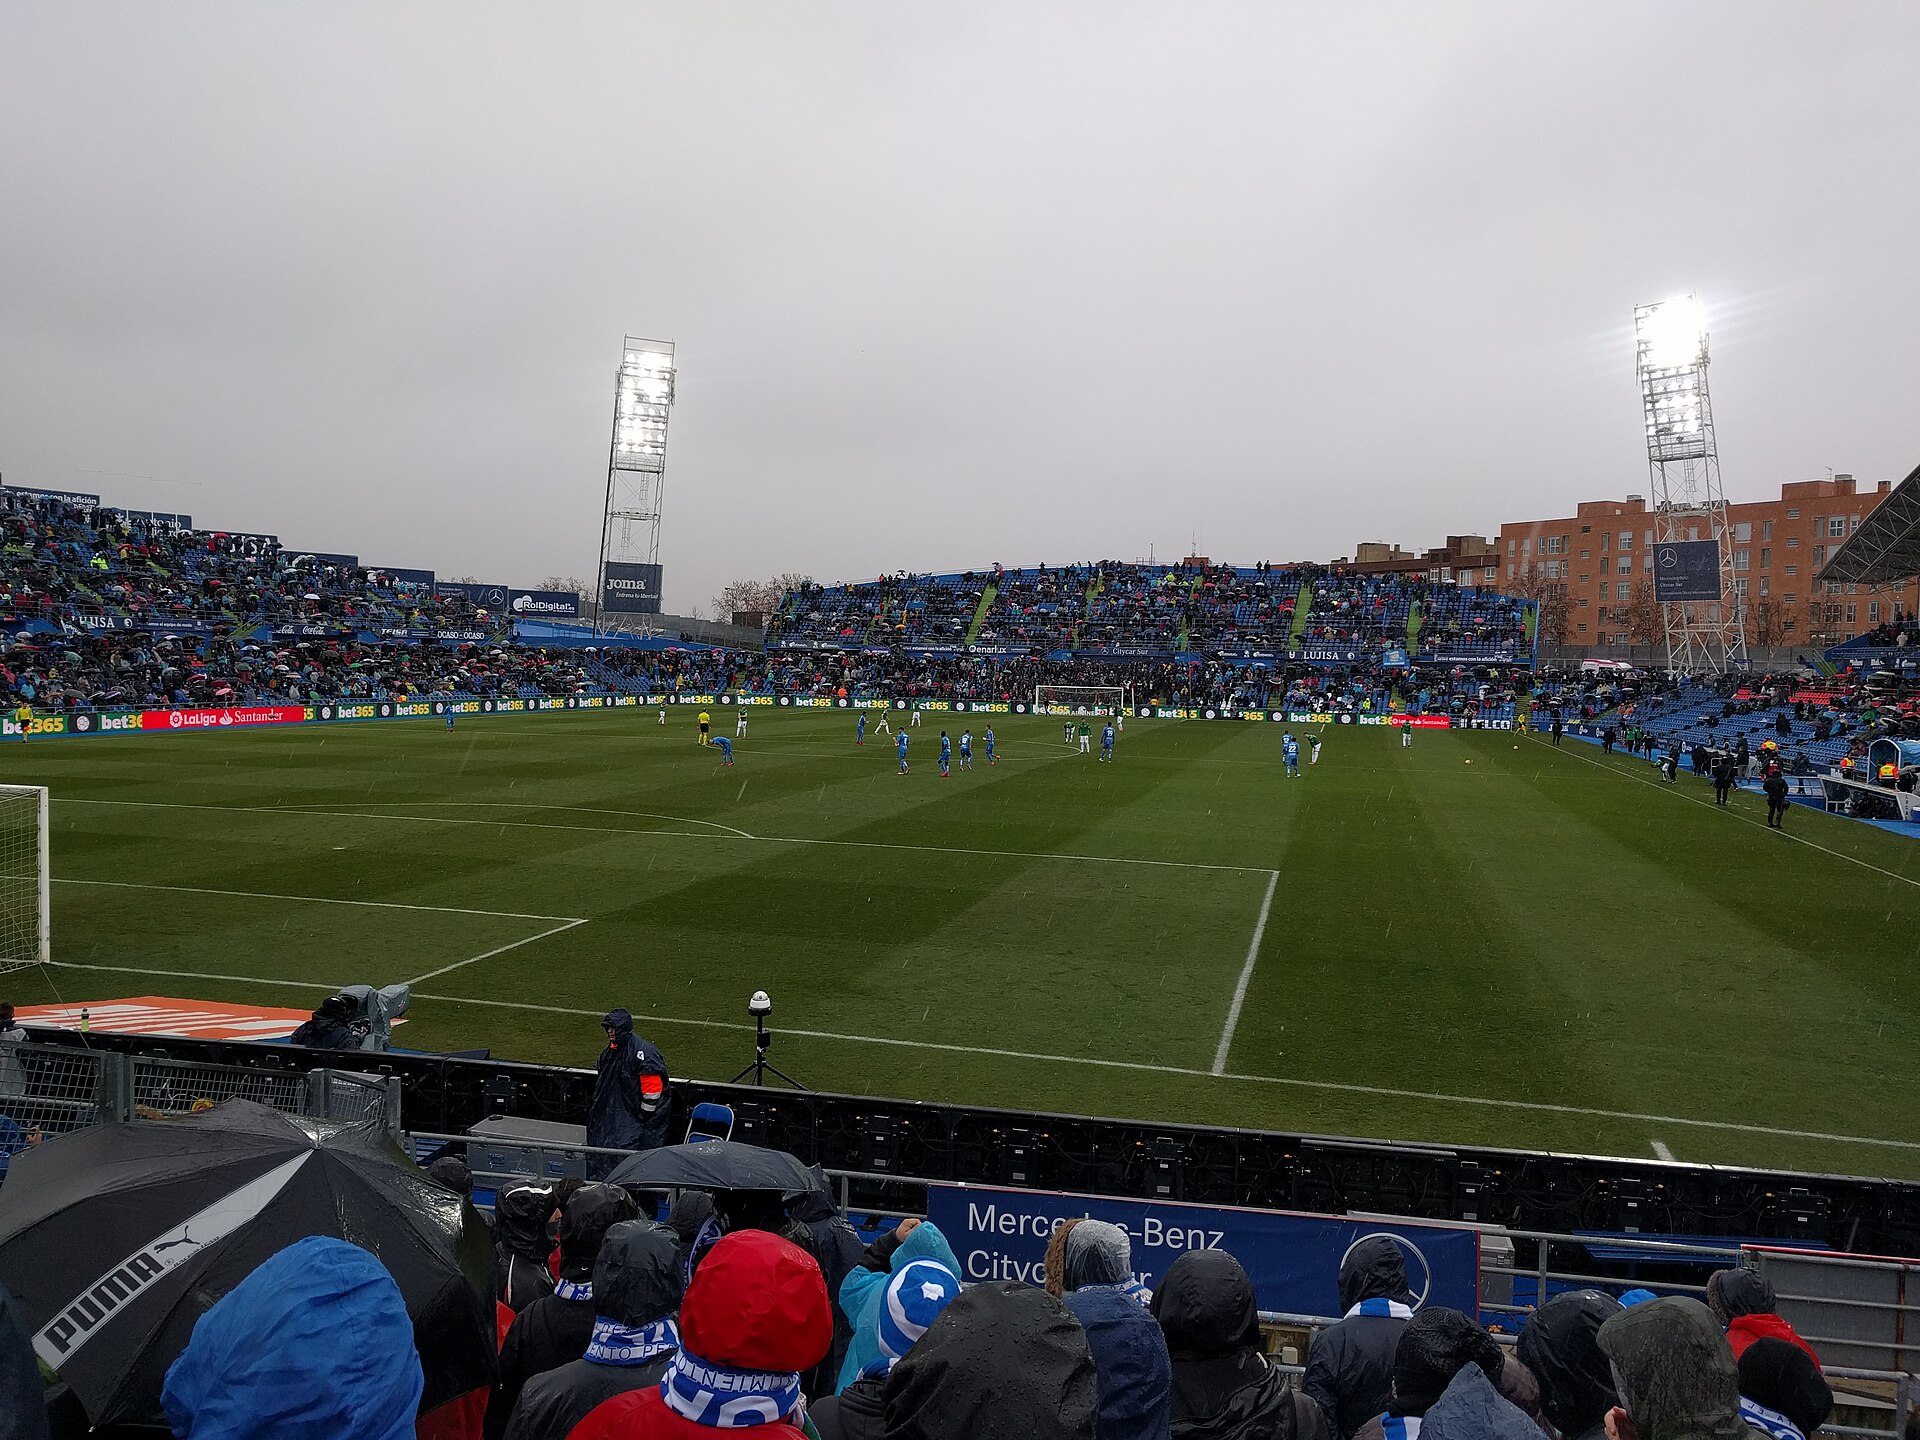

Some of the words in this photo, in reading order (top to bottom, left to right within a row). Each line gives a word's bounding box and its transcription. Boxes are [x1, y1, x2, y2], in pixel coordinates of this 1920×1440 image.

[497, 700, 524, 711] bet365
[539, 698, 564, 709] bet365
[579, 697, 603, 707] bet365
[615, 696, 636, 706] bet365
[679, 695, 714, 705] bet365
[737, 695, 773, 705] bet365
[796, 696, 832, 706] bet365
[854, 699, 890, 709] bet365
[338, 705, 374, 718] bet365
[396, 704, 430, 715] bet365
[972, 702, 1009, 712] bet365
[101, 714, 143, 730] bet36
[184, 713, 217, 726] LaLiga
[234, 709, 284, 723] Santander
[1290, 712, 1333, 723] bet365
[1360, 715, 1393, 725] bet36
[2, 717, 64, 734] be365
[967, 1202, 1225, 1253] Merces-Benz
[43, 1252, 165, 1354] PUMA
